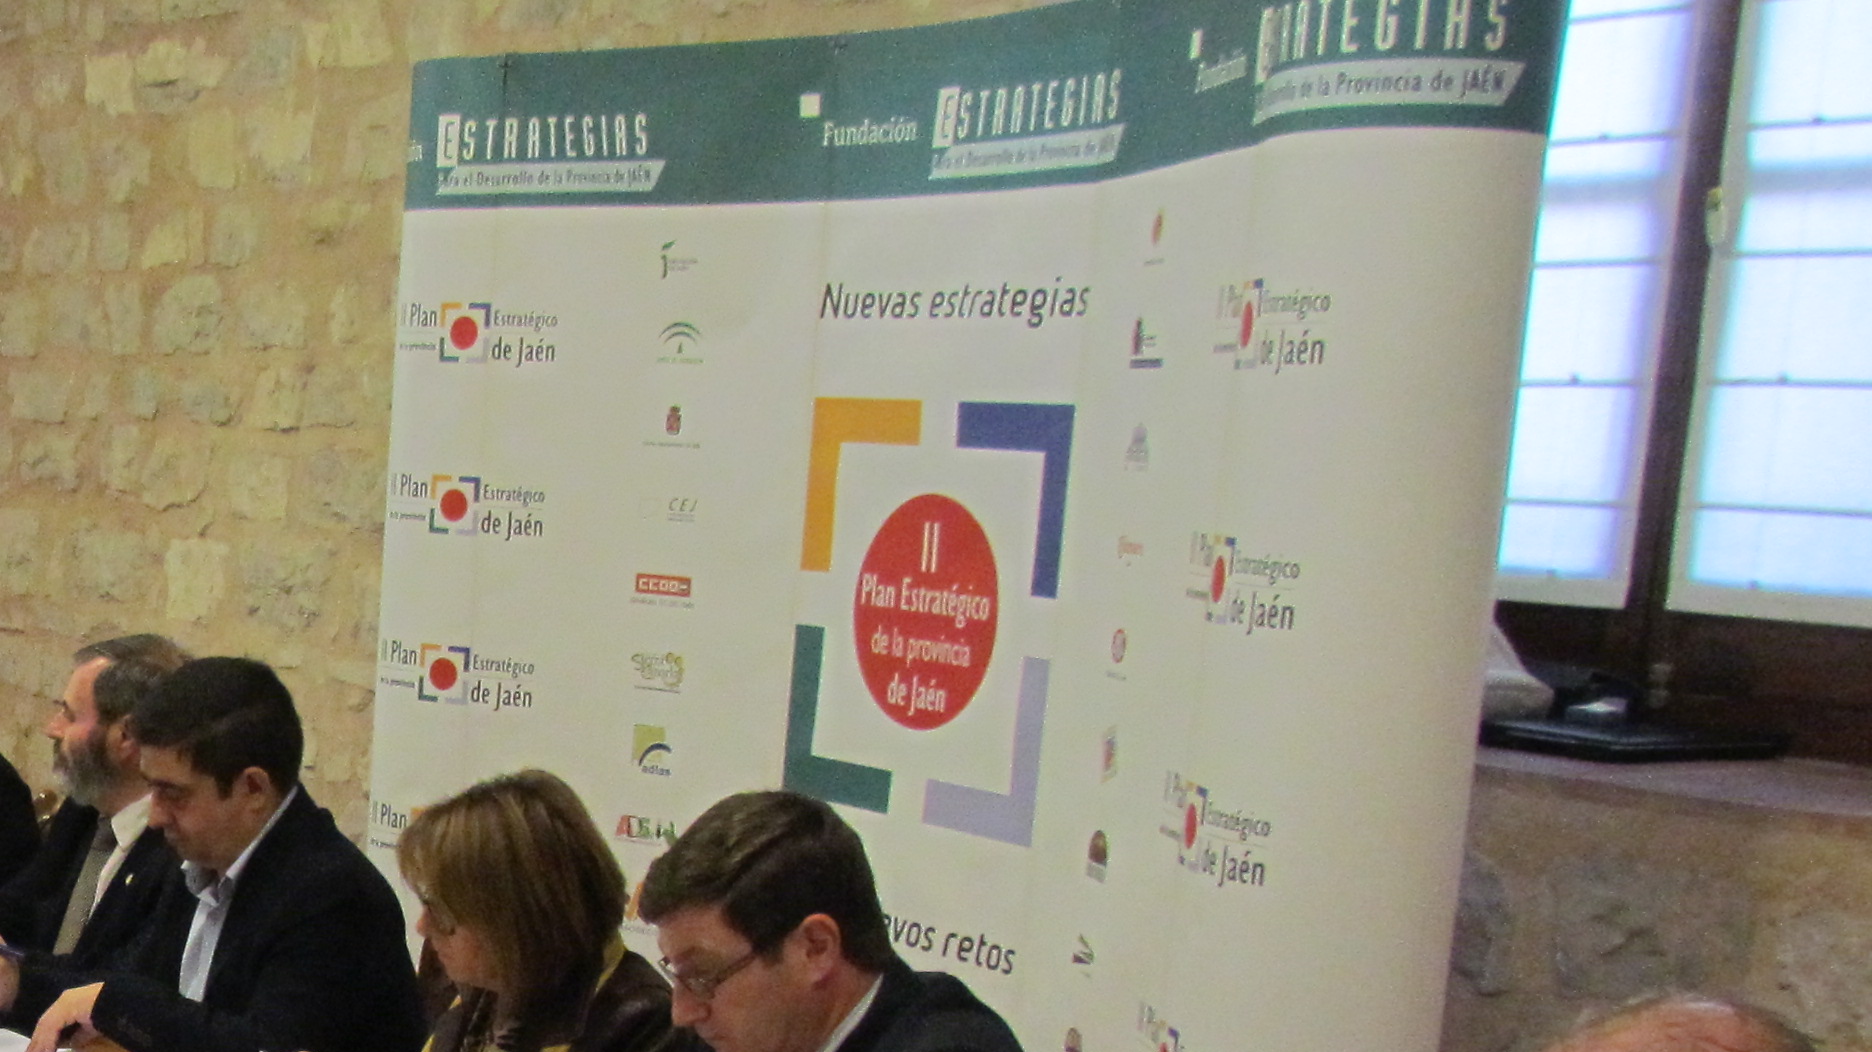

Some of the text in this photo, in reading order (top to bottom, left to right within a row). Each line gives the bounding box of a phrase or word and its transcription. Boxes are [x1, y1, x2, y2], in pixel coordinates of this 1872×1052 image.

[436, 113, 649, 168] ESTRATEGIAS
[822, 117, 918, 146] Fundación
[410, 303, 437, 328] Plan
[493, 309, 559, 333] Estratégico
[820, 277, 1090, 327] Nuevas estrategias
[491, 336, 556, 369] de Jaén
[1274, 329, 1325, 376] Jaén
[400, 474, 428, 498] Plan
[482, 485, 546, 507] Estratégico
[481, 510, 544, 542] de Jaén
[860, 572, 991, 629] Plan Estratégico
[1245, 591, 1295, 635] Jaén
[390, 640, 417, 666] Plan
[473, 653, 535, 678] Estratégico
[870, 624, 970, 668] de la provincia
[470, 679, 532, 712] de Jaén
[887, 673, 945, 716] de Jaén
[380, 801, 407, 830] Plan
[1217, 844, 1266, 887] Jaén
[941, 930, 1016, 975] retos
